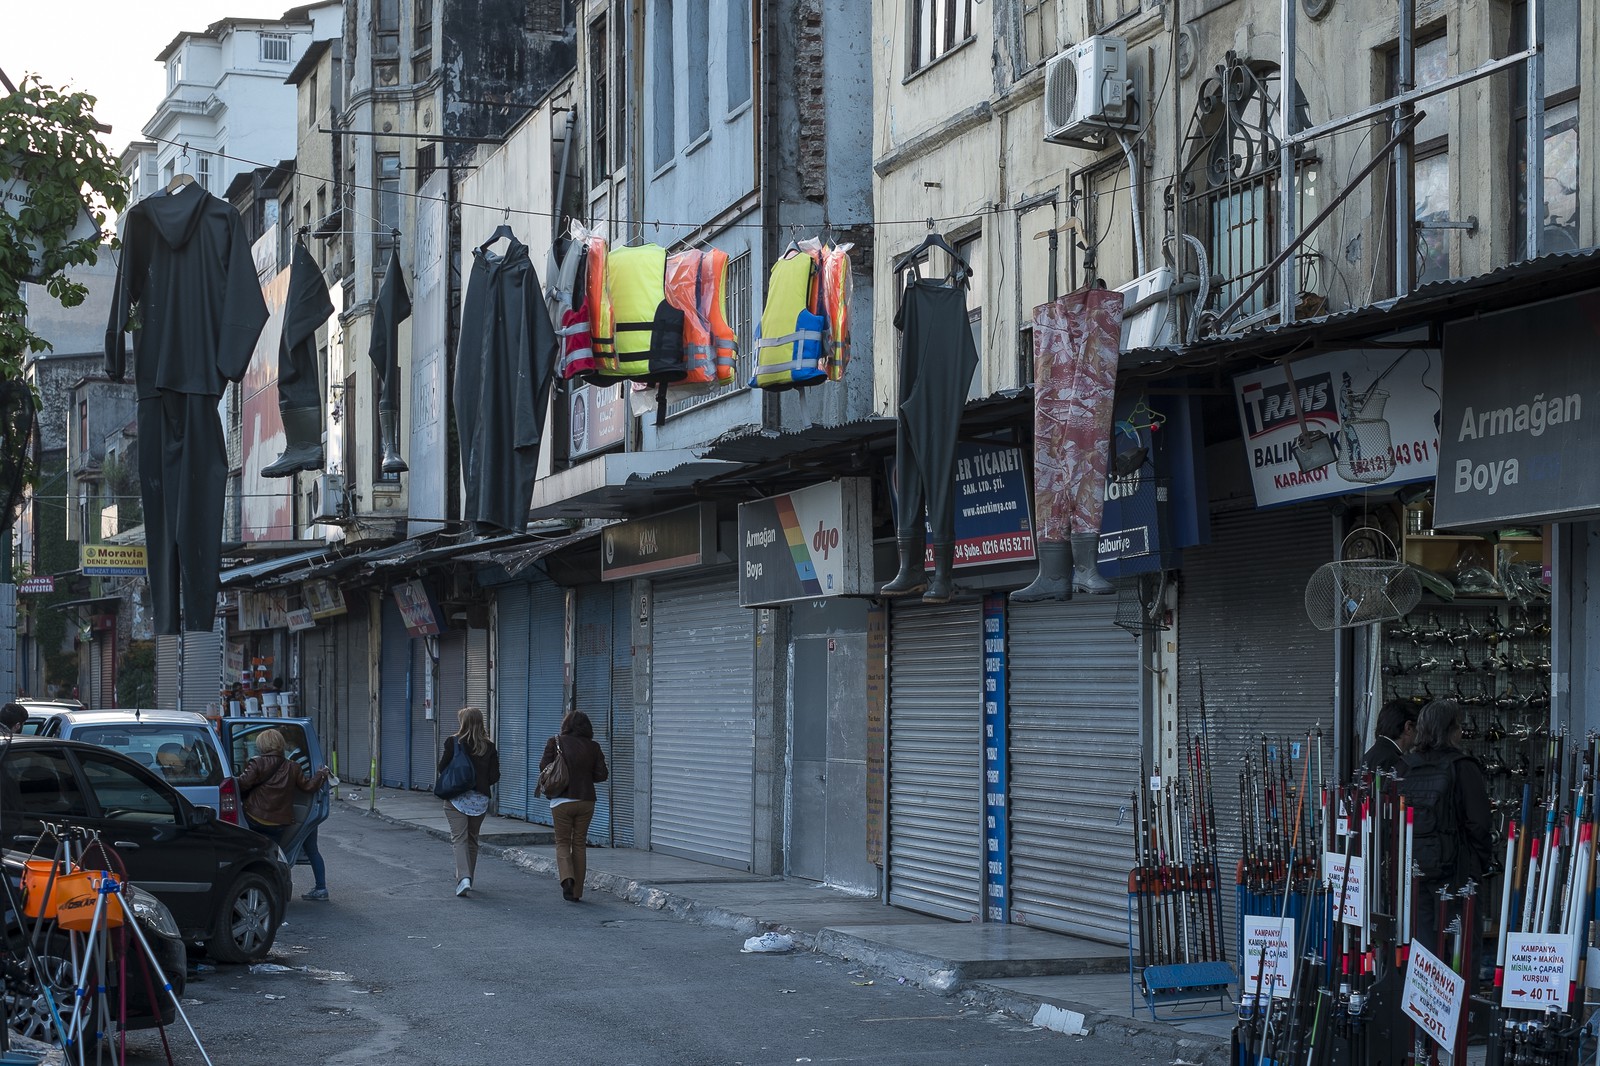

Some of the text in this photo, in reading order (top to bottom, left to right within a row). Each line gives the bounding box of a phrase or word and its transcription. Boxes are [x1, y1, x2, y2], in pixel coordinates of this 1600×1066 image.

[1458, 393, 1582, 442] Armağan
[1413, 440, 1429, 463] 61
[974, 448, 1019, 477] TİCARET
[1455, 458, 1519, 495] Boya
[746, 527, 776, 548] Armağan
[812, 520, 839, 560] dyo
[982, 540, 999, 556] 0216
[999, 537, 1012, 553] 415
[1012, 537, 1022, 552] 52
[1022, 536, 1031, 551] 77
[98, 549, 144, 558] Moravia
[746, 560, 763, 580] Boya
[21, 585, 54, 593] POLYESTER
[1349, 905, 1358, 917] TL
[1511, 954, 1532, 963] KAMIŞ
[1538, 954, 1564, 964] MAKİNA
[1521, 945, 1556, 954] KAMPANYA
[1414, 952, 1455, 998] KAMPANYA
[1511, 963, 1532, 972] MİSİNA
[1538, 965, 1564, 974] ÇAPARİ
[1522, 974, 1549, 983] KURŞUN
[1530, 988, 1560, 1001] 40 TL
